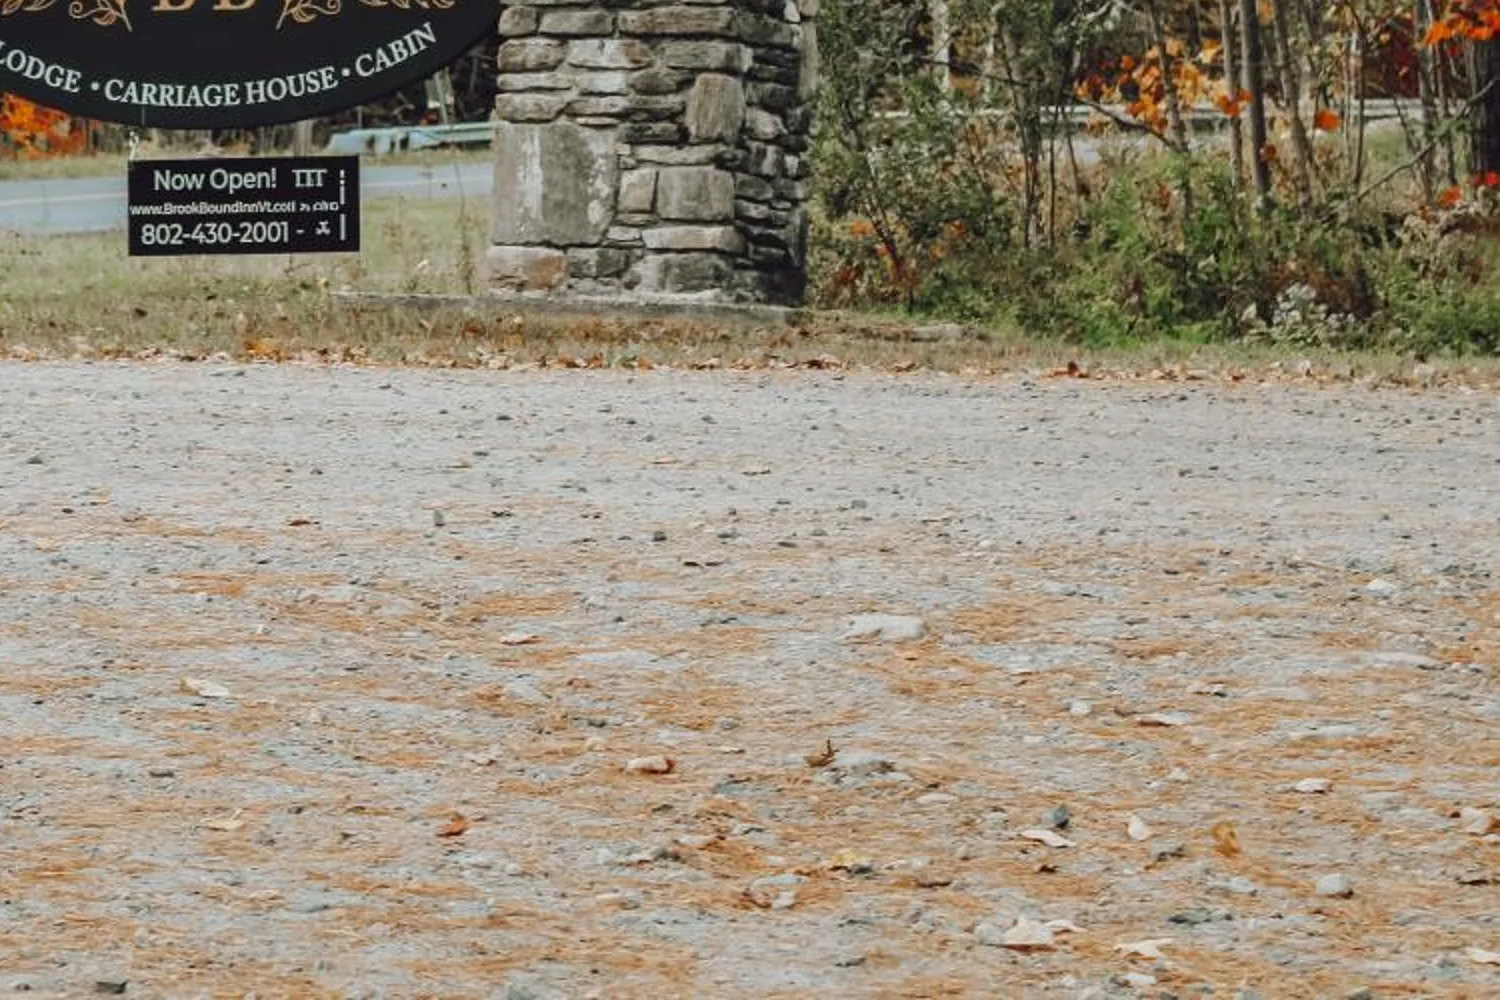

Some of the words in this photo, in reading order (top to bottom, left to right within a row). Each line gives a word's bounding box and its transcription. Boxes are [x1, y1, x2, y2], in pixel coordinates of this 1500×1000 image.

[105, 79, 240, 107] CARRIAGE
[245, 66, 338, 105] HOUSE
[356, 22, 437, 77] CABIN
[153, 169, 206, 191] Now
[210, 167, 277, 194] Open!
[141, 222, 289, 245] 802-430-2001
